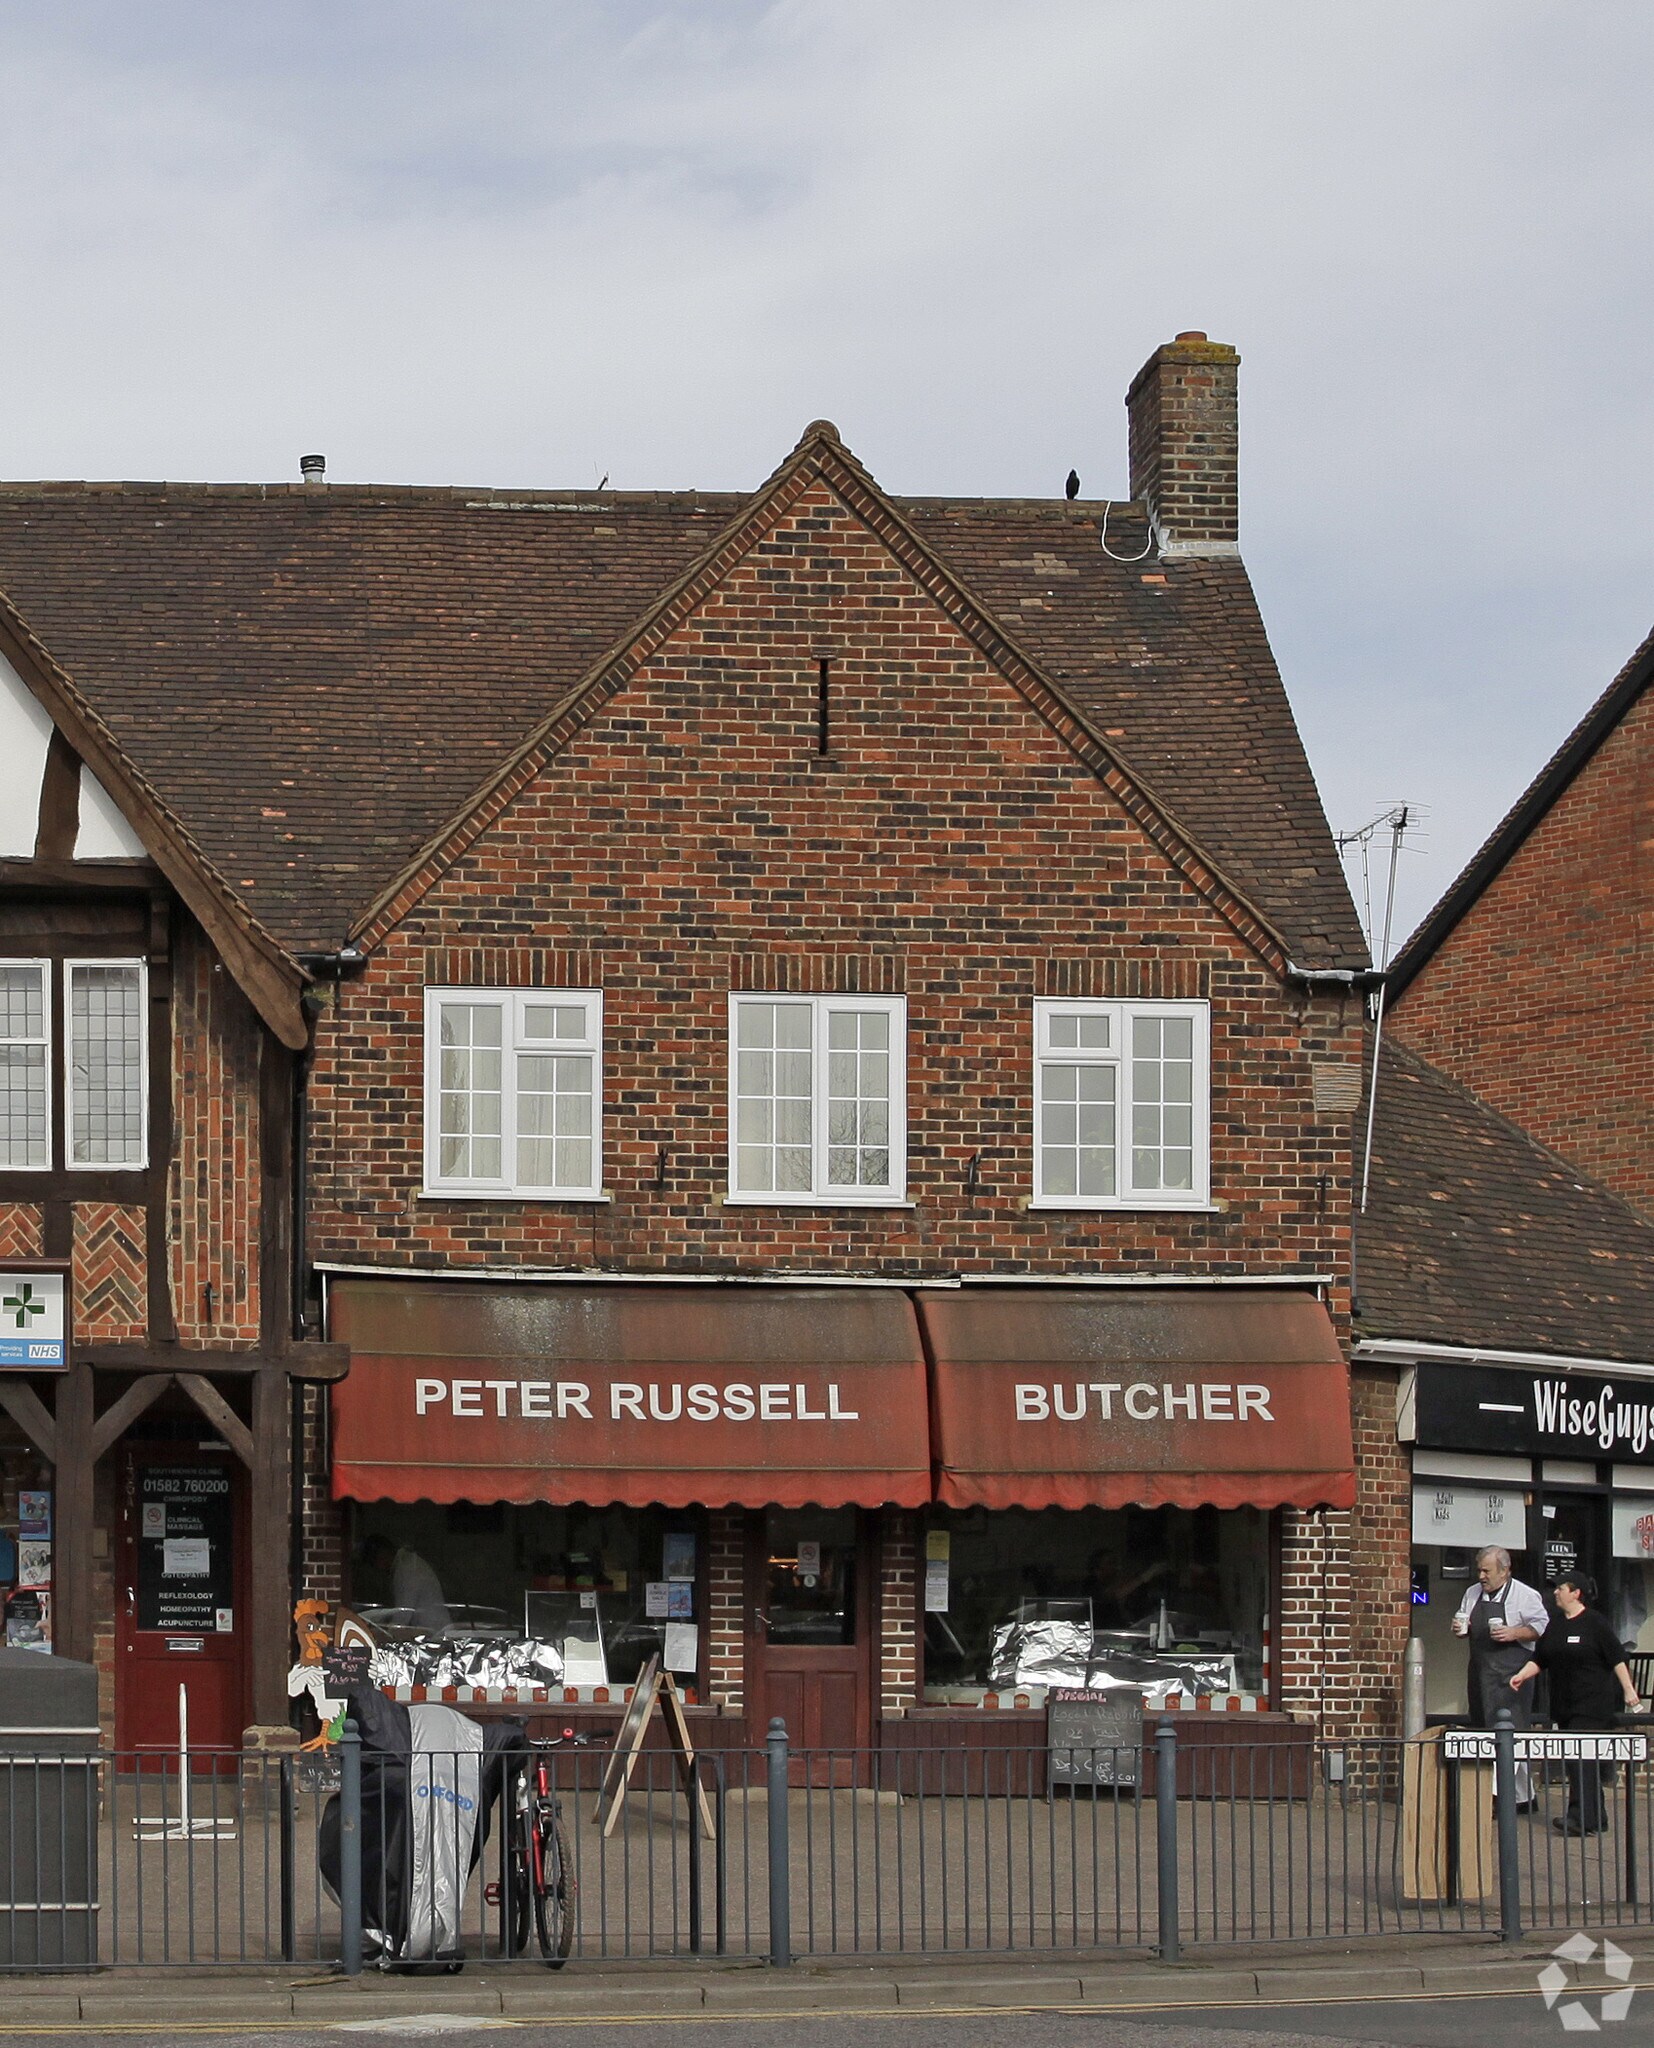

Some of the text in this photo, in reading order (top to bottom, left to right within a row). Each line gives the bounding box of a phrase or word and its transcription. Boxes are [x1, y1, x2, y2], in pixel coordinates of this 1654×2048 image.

[30, 1345, 59, 1357] NHS
[415, 1378, 859, 1421] PETER RUSSELL
[1014, 1383, 1275, 1421] BUTCHER
[143, 1479, 229, 1493] 01582 760200
[1435, 1508, 1450, 1520] Kids
